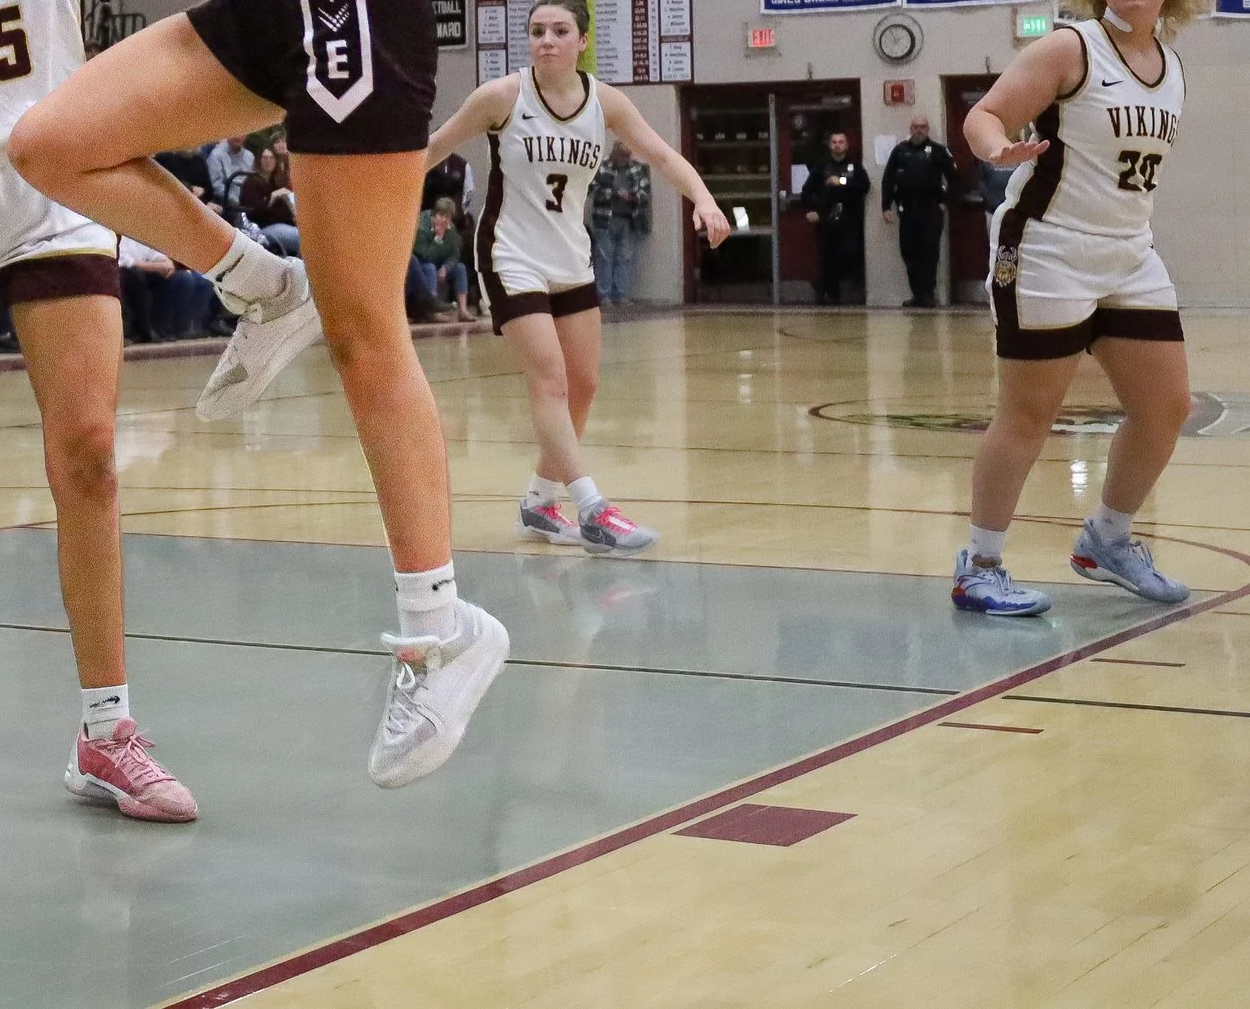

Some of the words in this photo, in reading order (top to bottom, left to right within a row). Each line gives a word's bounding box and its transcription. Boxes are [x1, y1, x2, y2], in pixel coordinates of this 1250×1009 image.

[326, 39, 350, 79] E
[1106, 105, 1180, 147] VIKING
[522, 136, 600, 170] VIKINGS
[545, 173, 568, 213] 3
